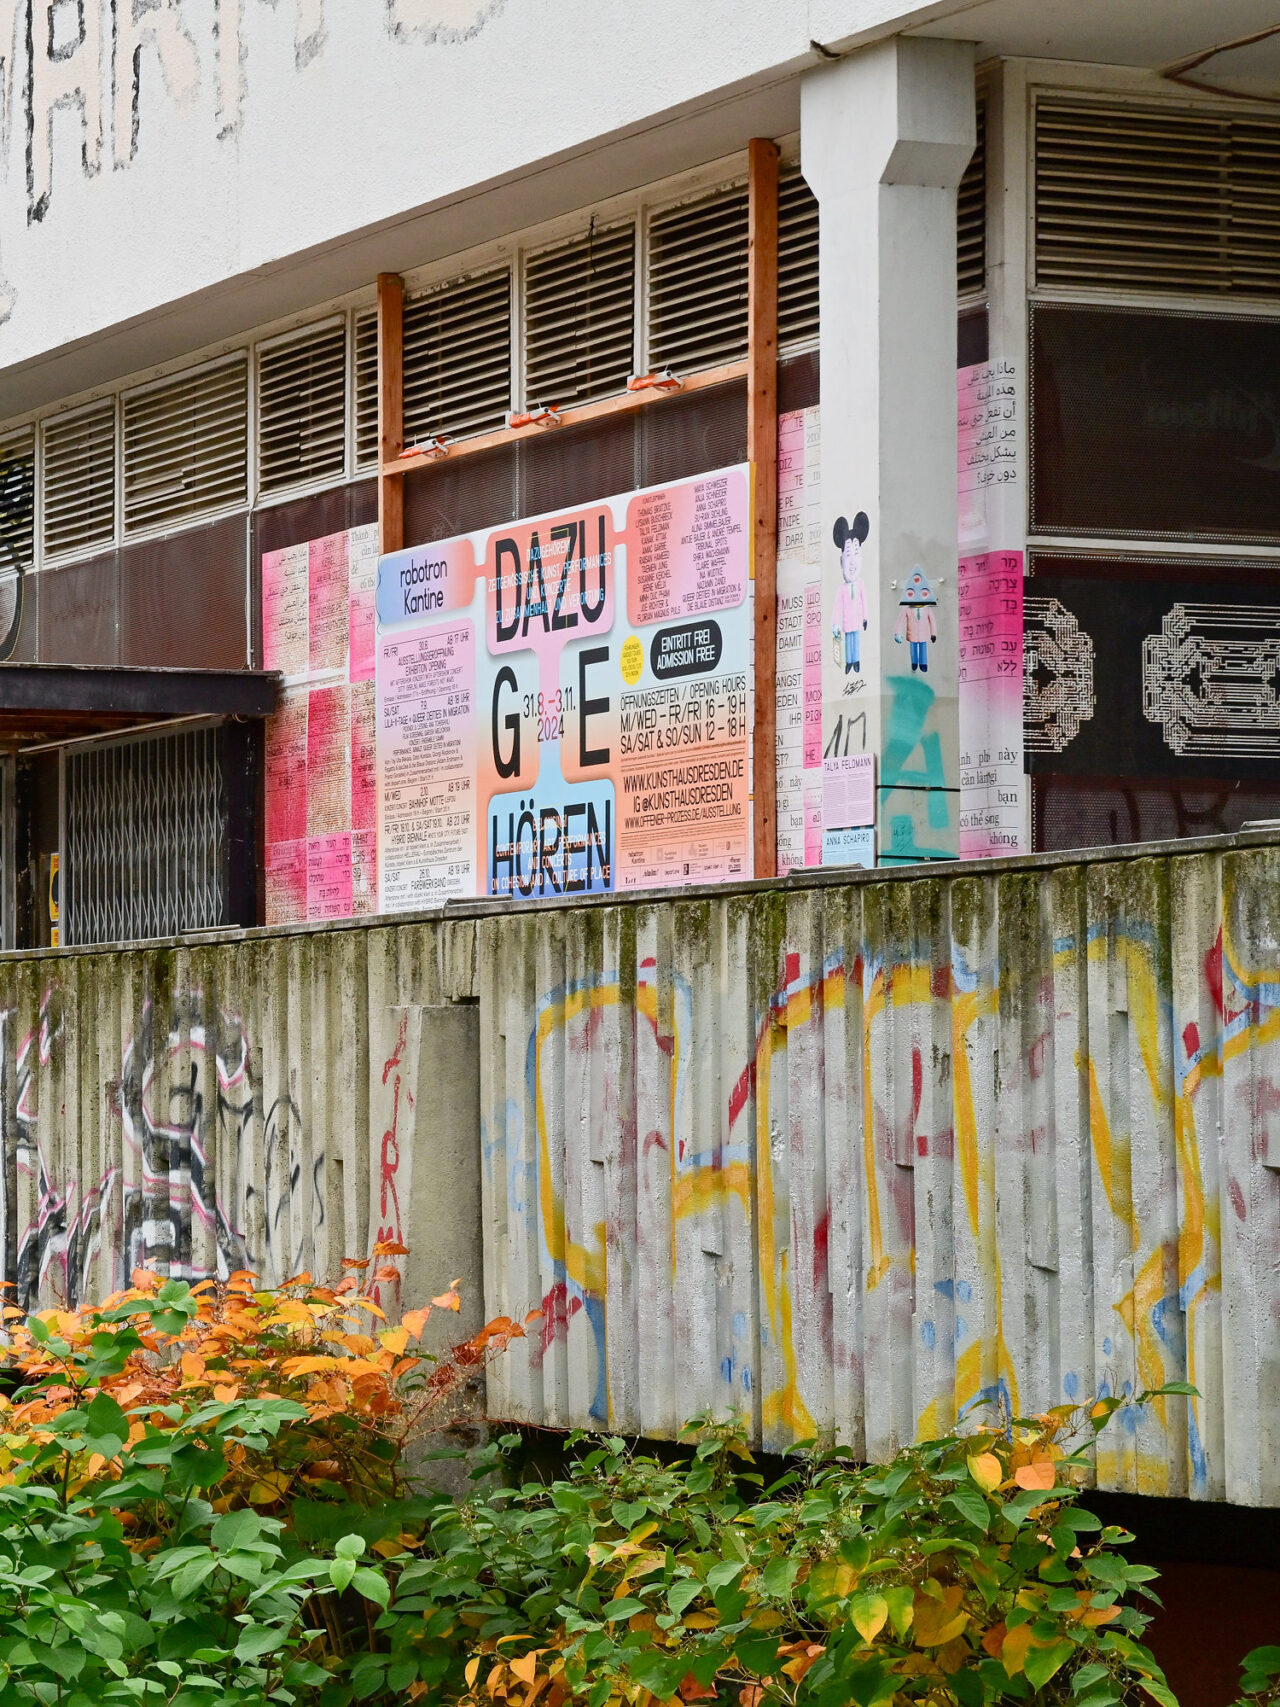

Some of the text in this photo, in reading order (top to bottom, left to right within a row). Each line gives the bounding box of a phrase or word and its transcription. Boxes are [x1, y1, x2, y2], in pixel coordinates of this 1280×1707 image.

[400, 559, 448, 588] robotron
[495, 515, 606, 643] DAZU
[404, 588, 444, 615] Kantine
[781, 595, 803, 611] MUSS
[779, 615, 803, 630] STADT
[661, 629, 710, 653] EINTRITT FREI
[778, 634, 803, 650] DAMIT
[657, 649, 694, 671] ADMISSION
[696, 645, 716, 662] FREE
[620, 675, 746, 711] ÖFFNUNGSZEITEN OPENING HOURS
[776, 673, 802, 688] ANGST
[492, 665, 520, 779] G
[579, 645, 610, 767] E
[620, 692, 746, 733] MI/WED FR/FRI 16 19 H
[789, 712, 802, 726] IHR
[537, 714, 565, 743] 2024
[620, 715, 746, 755] SA/SAT & SO/SUN 12 18 H
[623, 759, 744, 793] WWW.KUNSTHAUSDRESDEN.DE
[824, 761, 839, 772] TALYA
[633, 782, 733, 814] IG @KUNSTHAUSDRESDEN
[997, 789, 1018, 804] bạn
[492, 798, 611, 897] HÖREN
[826, 833, 870, 846] ANNA SCHAPIRO
